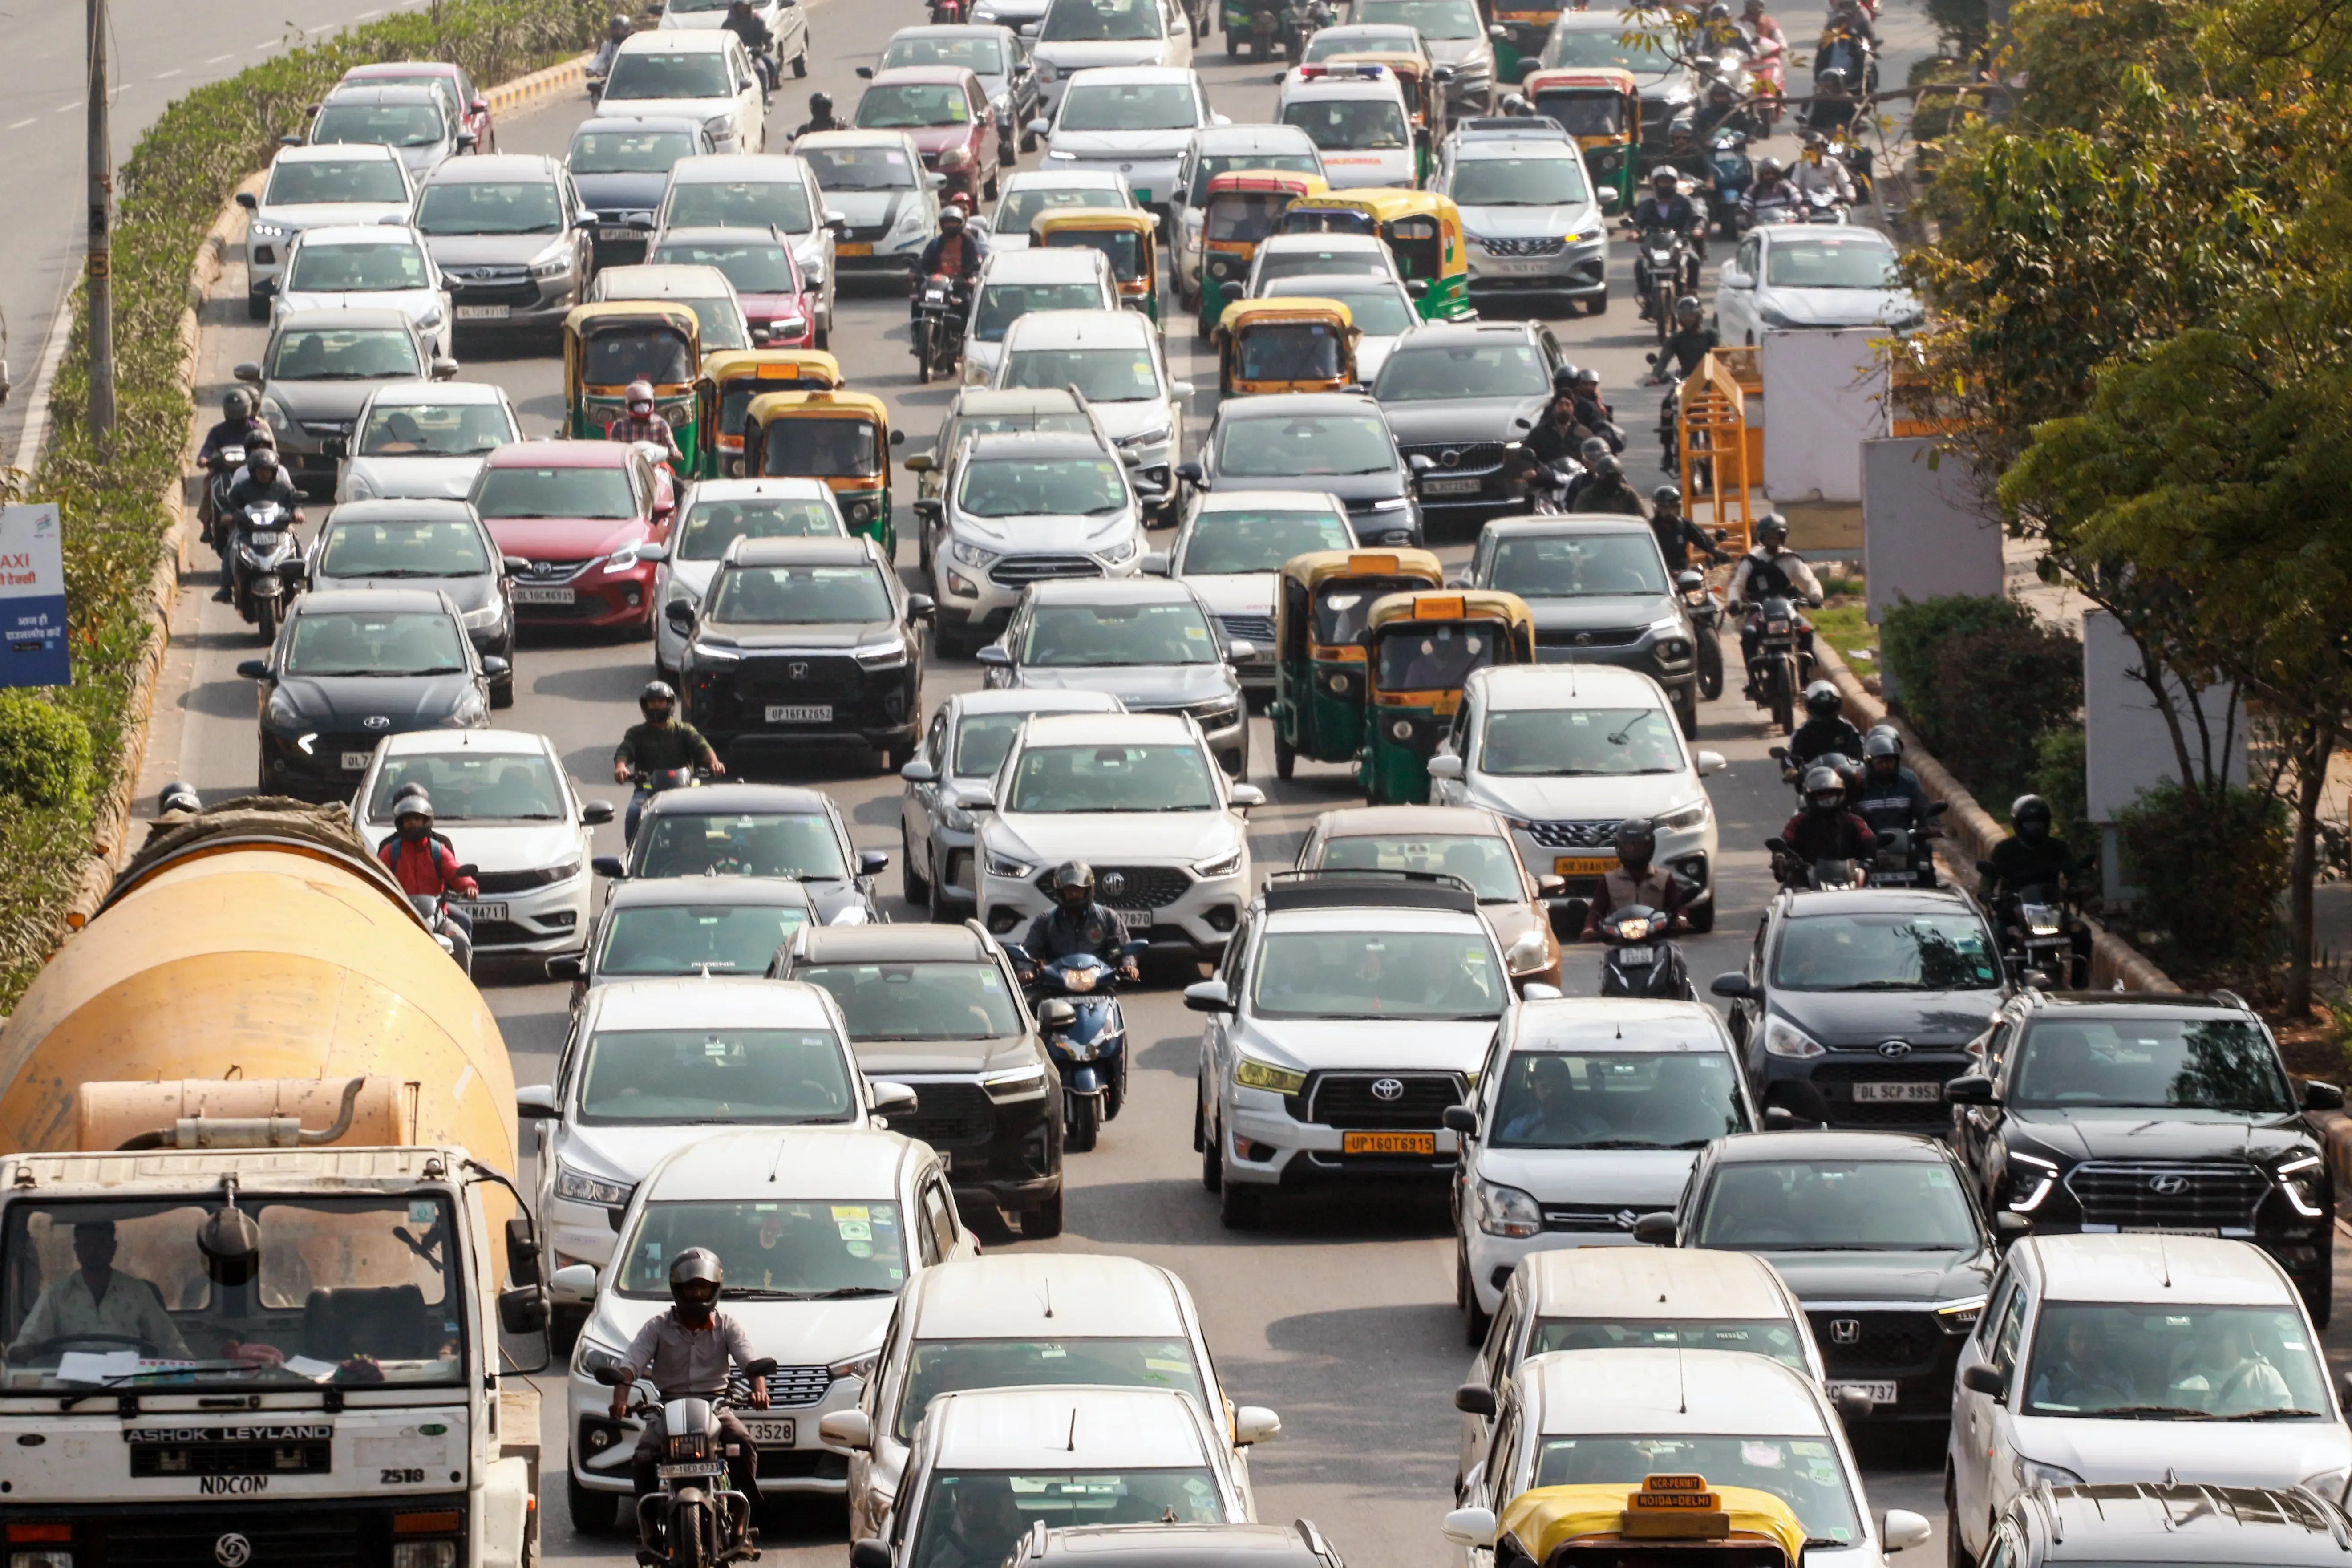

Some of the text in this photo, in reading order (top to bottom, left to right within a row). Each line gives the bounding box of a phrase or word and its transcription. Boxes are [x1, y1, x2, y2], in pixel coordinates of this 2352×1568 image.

[0, 553, 30, 568] AXI
[127, 1426, 332, 1442] ASHOK LEYLAND
[745, 1424, 792, 1440] T3528
[381, 1468, 425, 1484] 2518
[199, 1475, 268, 1495] NDCON
